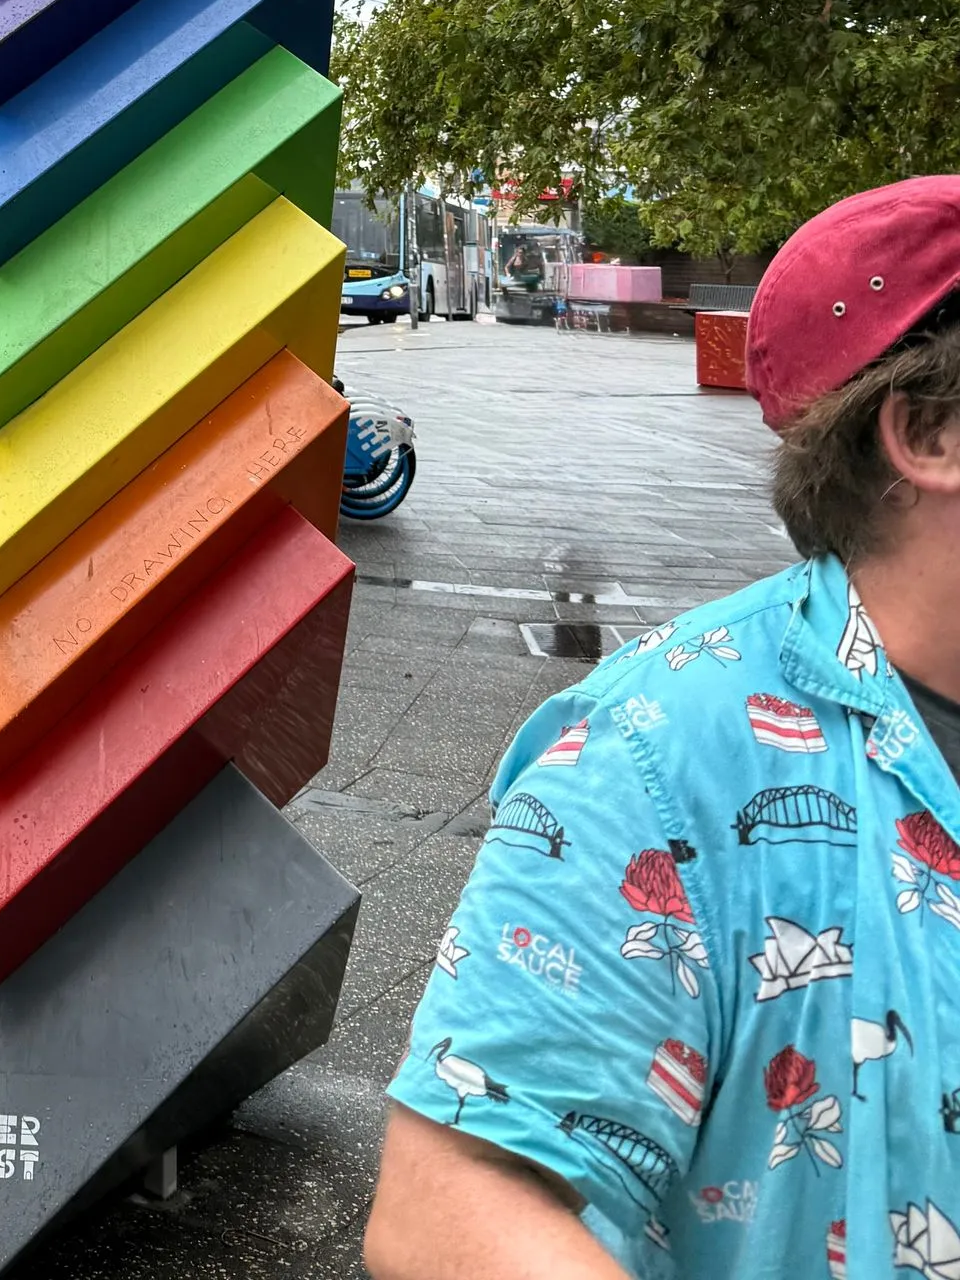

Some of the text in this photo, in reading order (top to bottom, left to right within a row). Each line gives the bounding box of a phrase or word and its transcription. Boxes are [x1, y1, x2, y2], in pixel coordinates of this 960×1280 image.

[52, 425, 308, 655] NO DRAWING HERE
[496, 942, 582, 992] SAUCE
[502, 922, 583, 972] LOCAL
